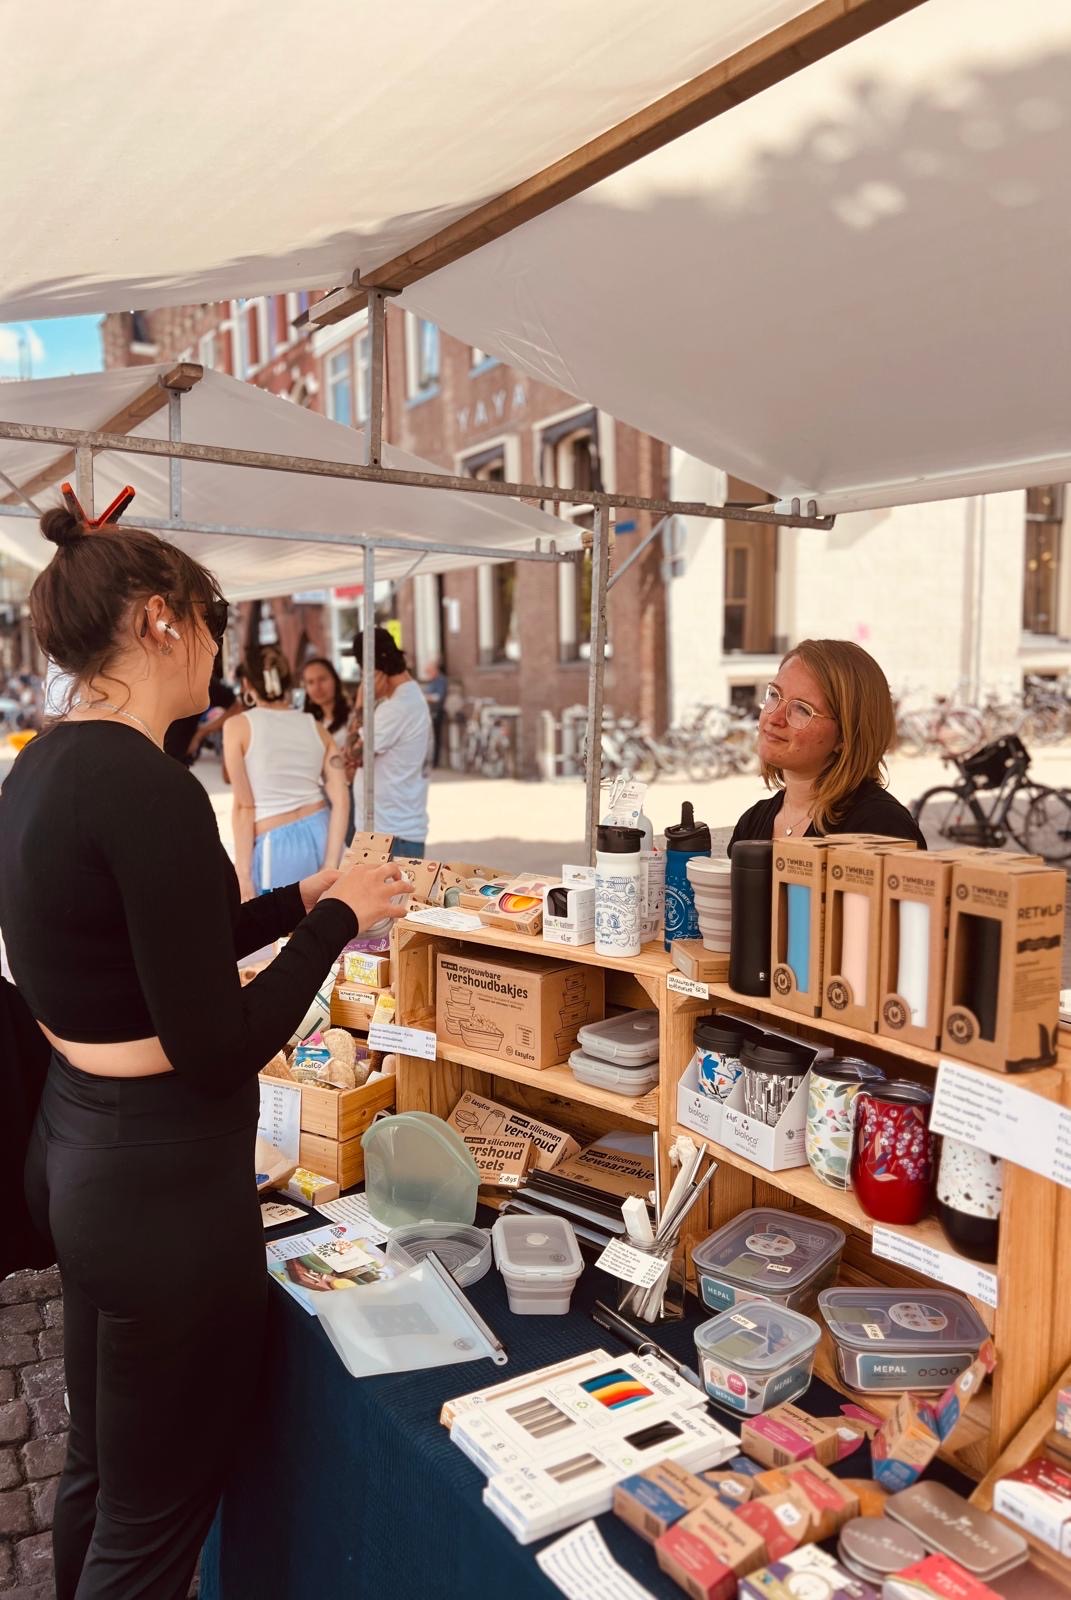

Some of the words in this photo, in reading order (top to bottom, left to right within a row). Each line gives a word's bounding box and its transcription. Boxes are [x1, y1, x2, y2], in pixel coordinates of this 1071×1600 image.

[456, 383, 528, 433] YAYA
[458, 965, 501, 981] opvouwbare
[446, 971, 528, 999] vershoudbakjes
[514, 1049, 535, 1061] EasyEco
[471, 1099, 490, 1111] EasyEco
[505, 1123, 558, 1154] vershoud
[529, 1124, 561, 1142] siliconen
[486, 1139, 525, 1149] siliconen
[469, 1145, 523, 1160] ershoud
[607, 1153, 642, 1167] siliconen
[707, 1286, 730, 1300] MEPAL
[873, 1365, 907, 1374] MEPAL
[774, 1377, 792, 1392] MEPAL
[715, 1390, 736, 1404] MEPAL
